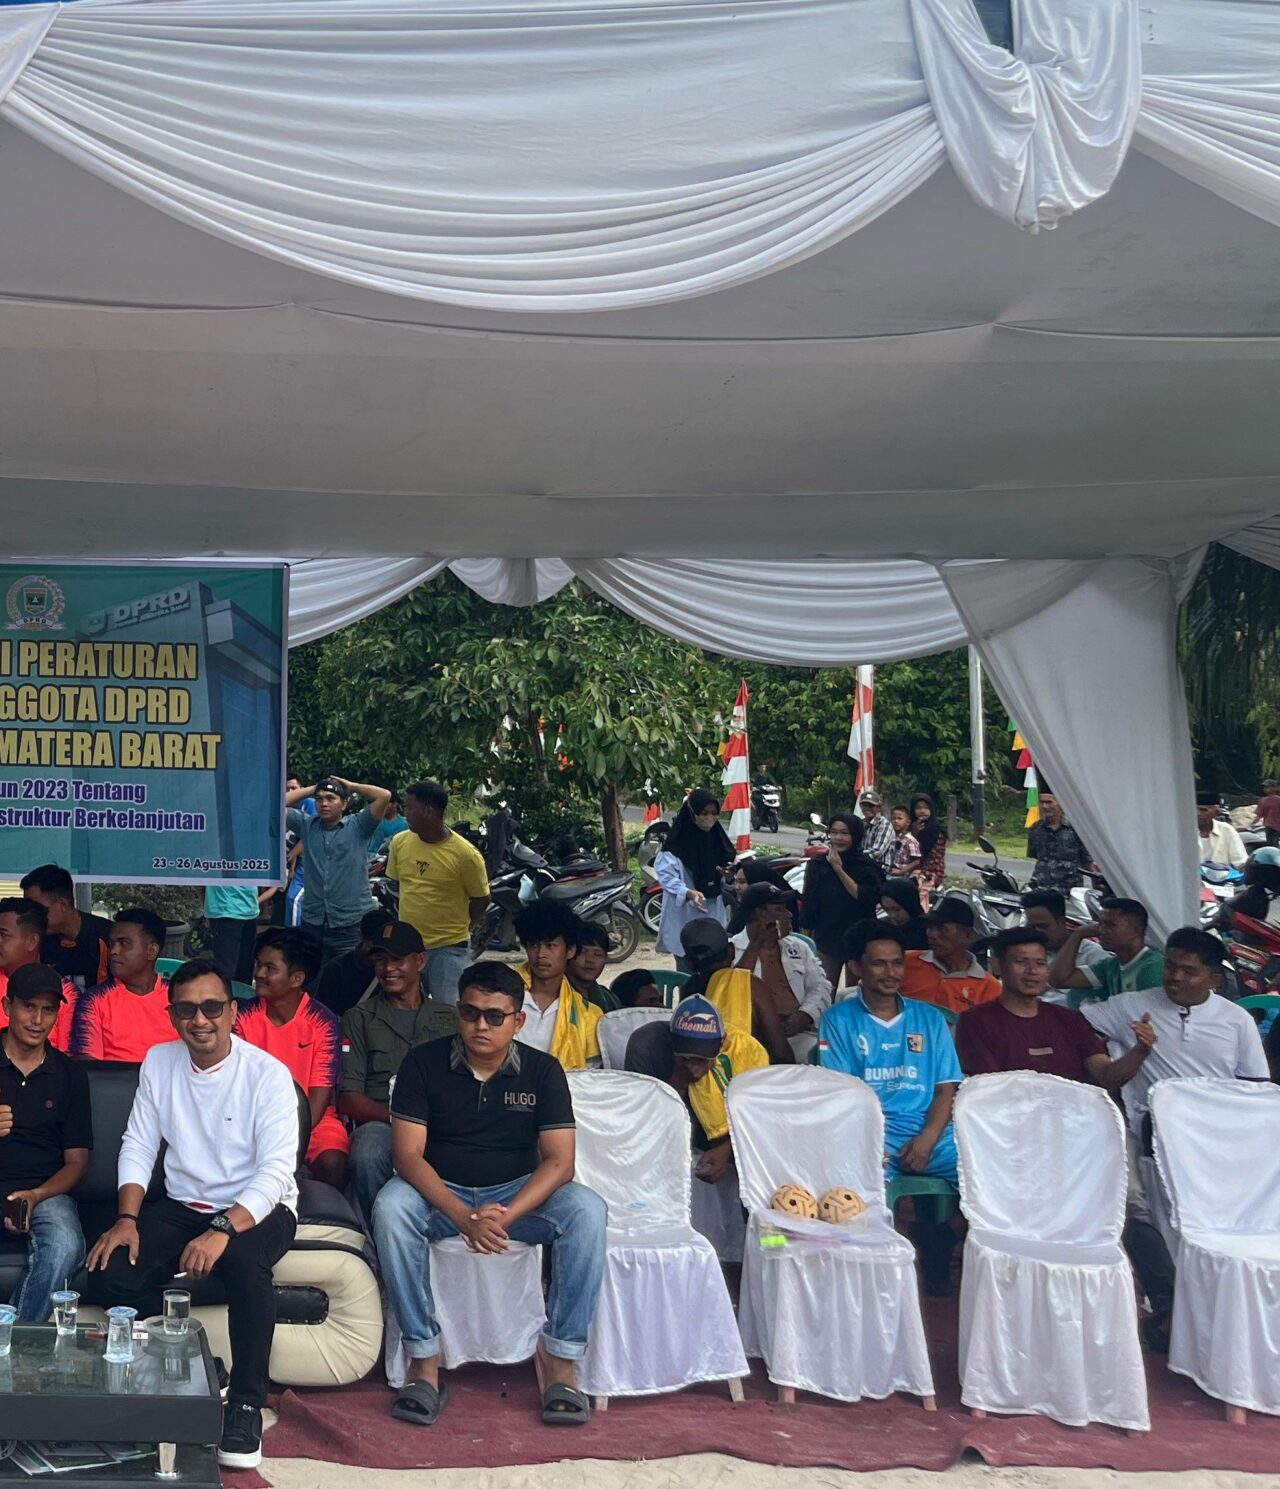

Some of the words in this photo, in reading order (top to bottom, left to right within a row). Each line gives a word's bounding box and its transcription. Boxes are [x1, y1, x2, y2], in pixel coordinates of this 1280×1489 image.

[114, 586, 190, 622] DPRD
[23, 616, 47, 624] DPRD
[19, 641, 198, 680] PERATURAN
[104, 686, 192, 724] DPRD
[119, 732, 222, 769] BARAT
[22, 780, 68, 800] 2023
[72, 781, 146, 803] Tentang
[74, 808, 205, 832] Berkelanjutan
[153, 857, 167, 868] 23
[176, 858, 191, 869] 26
[193, 859, 239, 872] Agustus
[241, 859, 270, 870] 2025
[504, 1091, 537, 1106] HUGO
